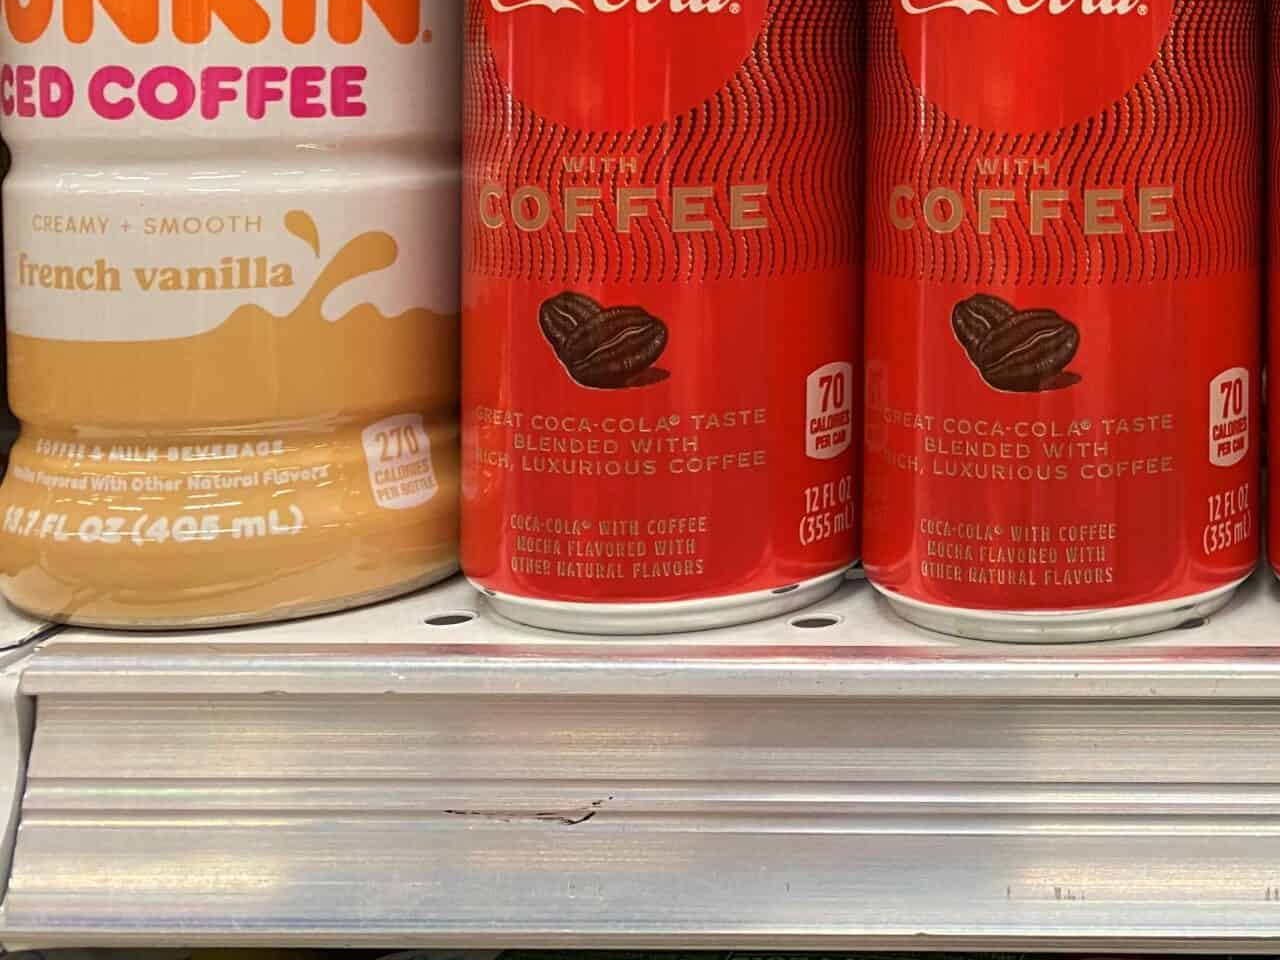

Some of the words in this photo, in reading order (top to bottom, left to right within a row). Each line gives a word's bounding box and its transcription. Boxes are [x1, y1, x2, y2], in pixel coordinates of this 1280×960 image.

[0, 64, 74, 118] CED
[88, 65, 367, 120] COFFEE
[563, 157, 637, 174] WITH
[975, 157, 1050, 176] WITH
[479, 184, 769, 233] COFFEE
[889, 184, 1176, 236] COFFEE
[32, 214, 110, 234] CREAMY
[143, 215, 263, 235] SMOOTH
[18, 252, 122, 292] french
[133, 256, 294, 292] vanilla
[818, 372, 845, 413] 70
[1218, 377, 1243, 420] 70
[690, 408, 767, 431] TASTE
[1101, 413, 1174, 436] TASTE
[375, 425, 419, 464] 270
[513, 436, 619, 455] BLENDED
[631, 436, 699, 455] WITH
[923, 437, 1031, 459] BLENDED
[1042, 441, 1110, 458] WITH
[521, 455, 657, 476] LUXURIOUS
[670, 450, 767, 474] COFFEE
[932, 460, 1070, 481] LUXURIOUS
[1079, 455, 1175, 480] COFFEE
[131, 476, 182, 493] Other
[187, 471, 260, 492] Natural
[263, 465, 329, 486] Flavors
[804, 485, 821, 514] 12
[822, 482, 836, 511] FL
[838, 476, 852, 503] OZ
[1207, 494, 1223, 522] 12
[1223, 491, 1236, 518] FL
[1237, 483, 1250, 511] OZ
[40, 513, 67, 541] FL
[79, 515, 127, 543] OZ
[132, 514, 220, 545] (405
[231, 505, 305, 540] mL)
[600, 520, 640, 536] WITH
[646, 516, 707, 535] COFFEE
[799, 511, 832, 546] (355
[1010, 525, 1051, 541] WITH
[1058, 522, 1118, 540] COFFEE
[1202, 519, 1231, 555] (355
[567, 539, 647, 557] FLAVORED
[654, 538, 697, 556] WITH
[978, 545, 1058, 564] FLAVORED
[1065, 545, 1107, 563] WITH
[556, 560, 624, 579] NATURAL
[632, 559, 706, 578] FLAVORS
[967, 566, 1036, 587] NATURAL
[1043, 567, 1114, 586] FLAVORS
